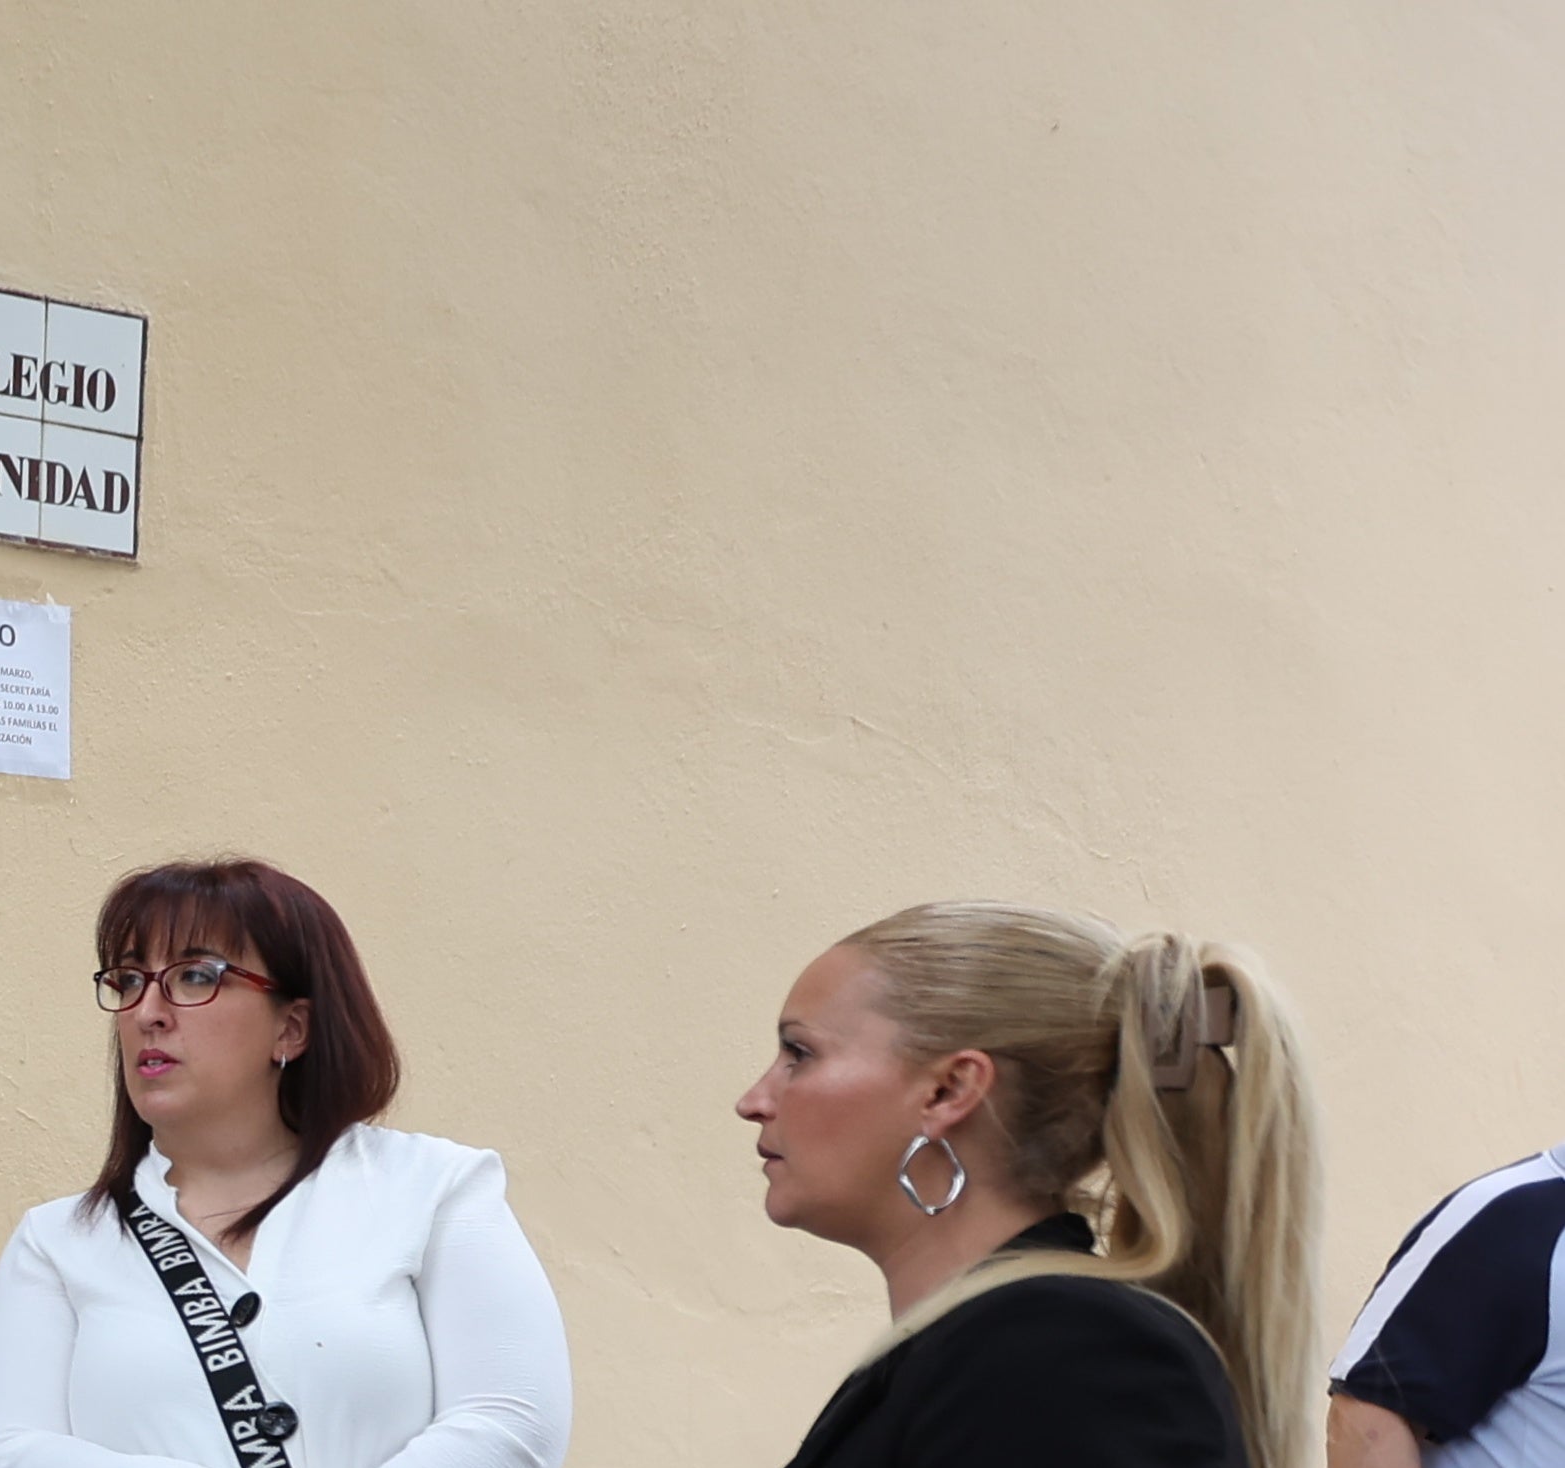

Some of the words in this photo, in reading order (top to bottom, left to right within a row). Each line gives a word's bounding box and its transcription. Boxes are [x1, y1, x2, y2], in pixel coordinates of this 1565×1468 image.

[0, 683, 51, 697] SECRETARÍA
[3, 700, 25, 711] 10.00
[28, 704, 34, 712] A
[7, 717, 46, 730] FAMILIAS
[49, 722, 58, 732] EL
[175, 1276, 246, 1373] BIMBA
